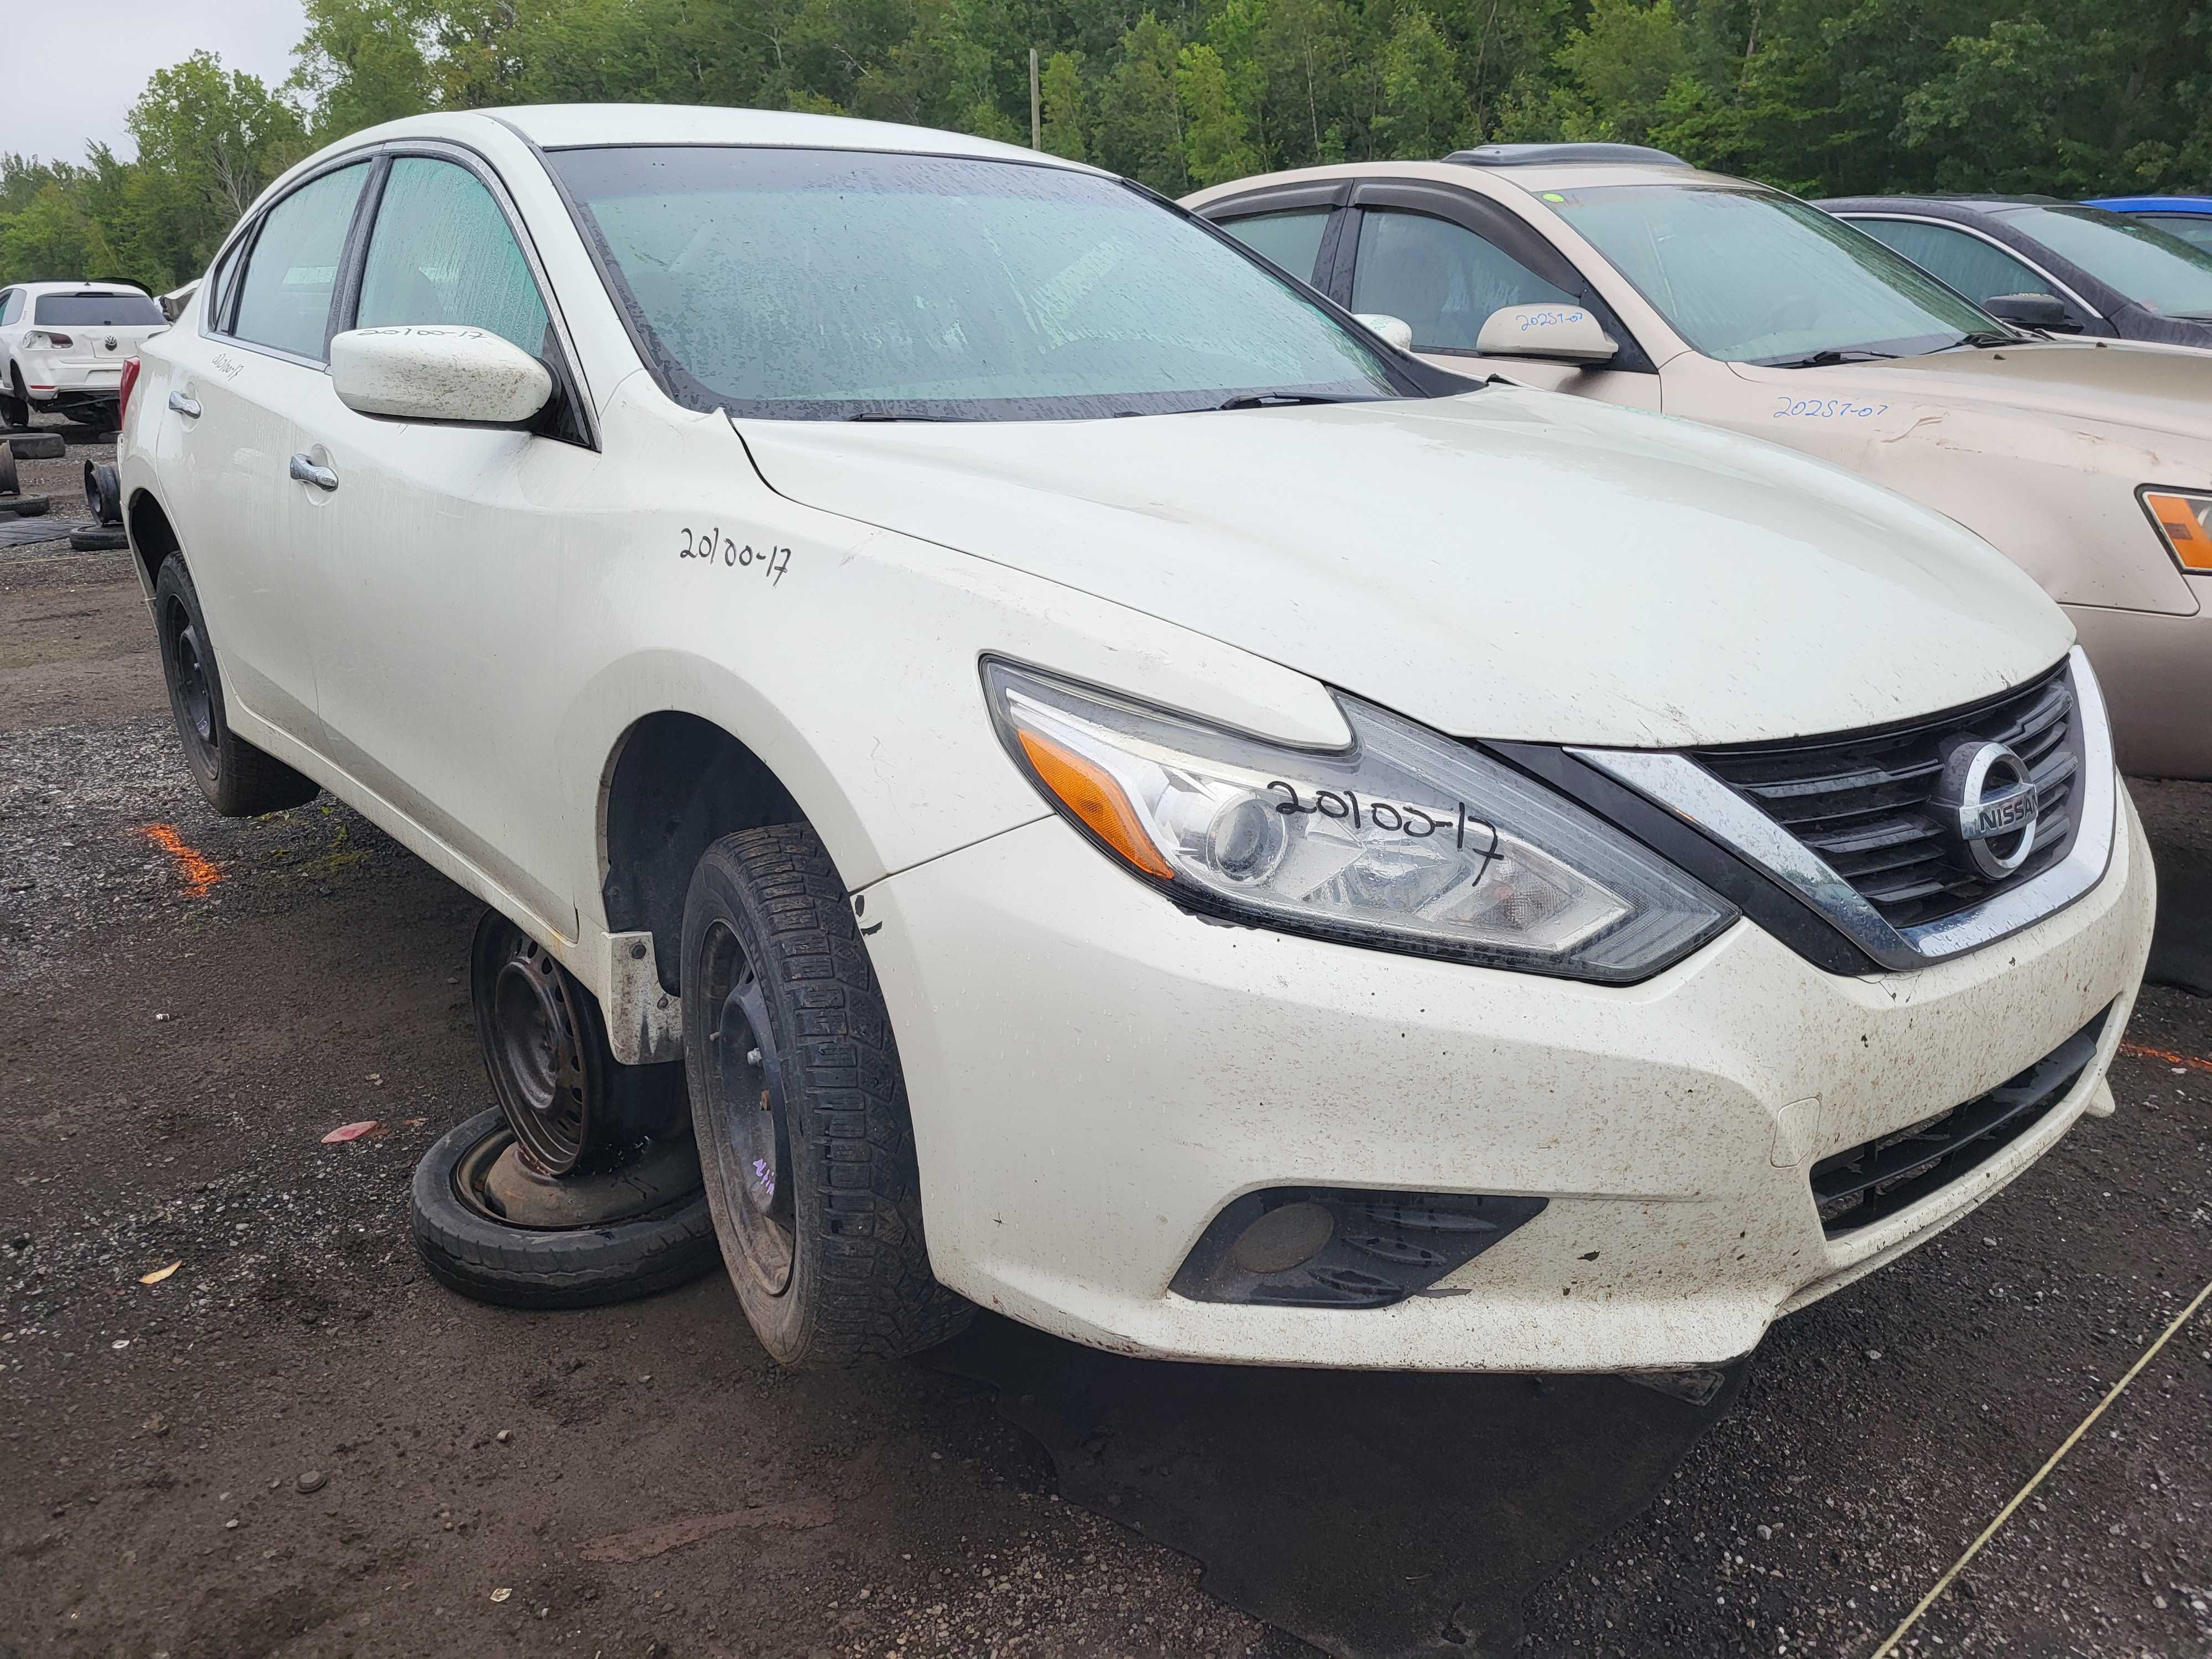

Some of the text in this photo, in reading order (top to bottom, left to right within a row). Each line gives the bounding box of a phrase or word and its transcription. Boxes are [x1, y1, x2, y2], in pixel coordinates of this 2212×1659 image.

[357, 328, 487, 340] 20100-17
[680, 527, 791, 587] 20100-17
[1267, 781, 1504, 886] 20100-17
[1979, 795, 2038, 832] NISSAN
